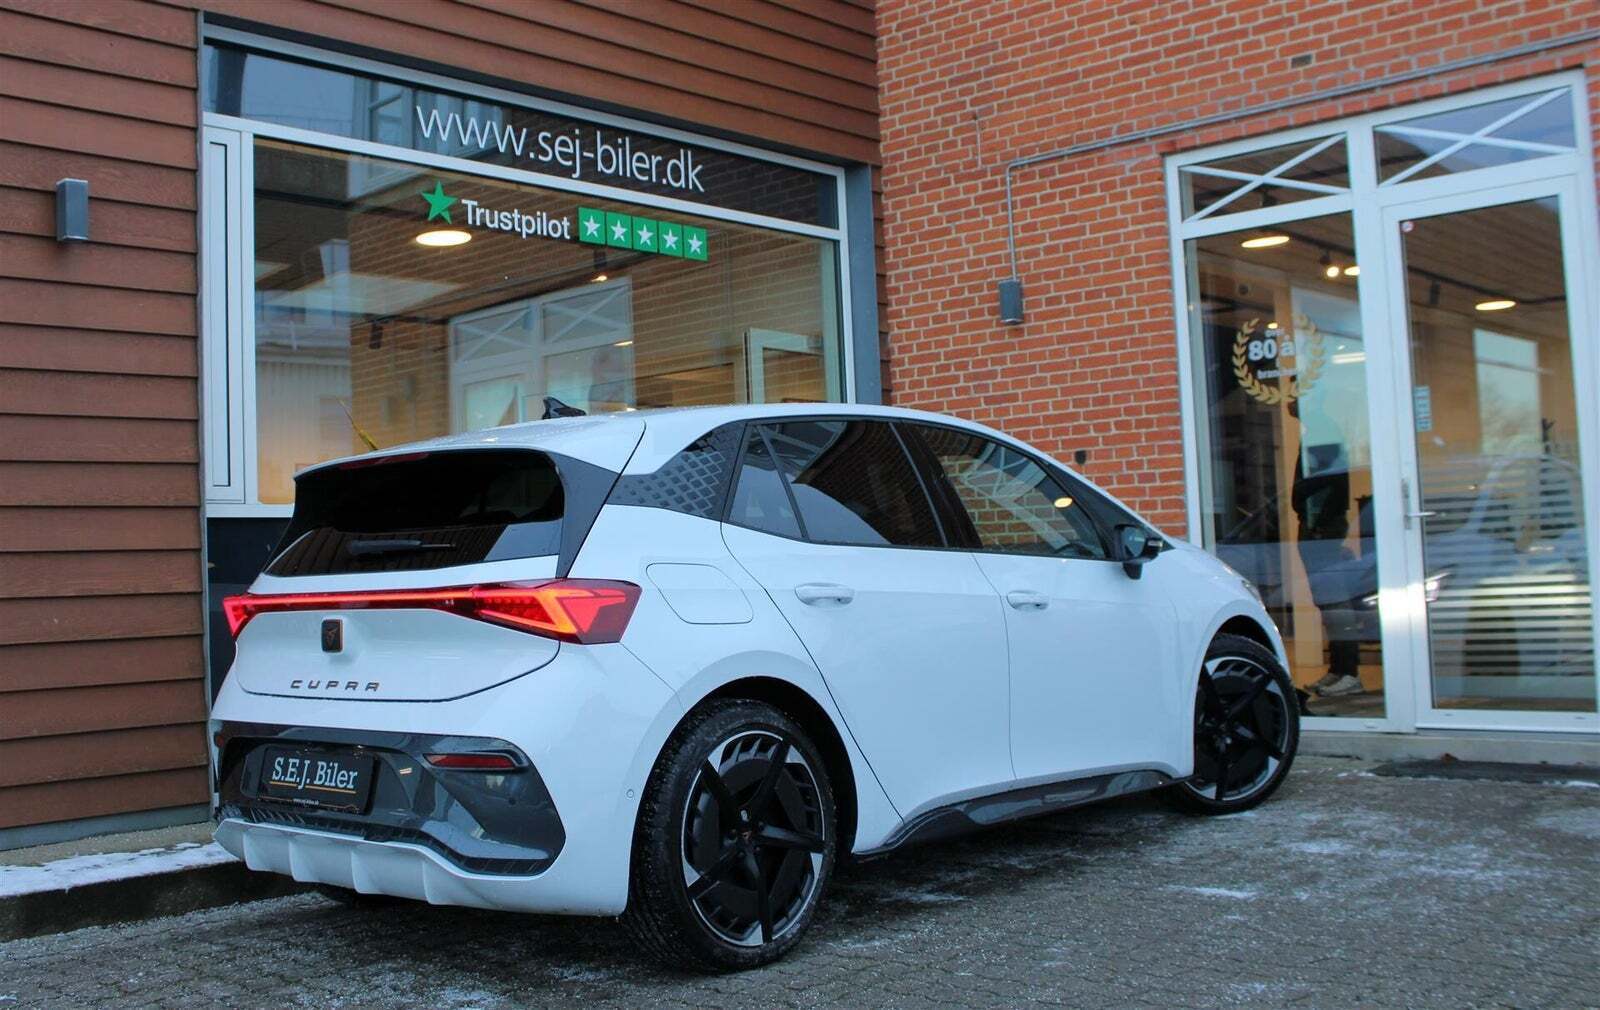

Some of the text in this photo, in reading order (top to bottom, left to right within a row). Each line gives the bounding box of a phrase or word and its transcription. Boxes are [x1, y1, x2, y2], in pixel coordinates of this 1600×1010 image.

[416, 105, 705, 193] www.sej-biler.dk
[461, 199, 571, 240] Trustpilot
[1248, 338, 1278, 361] 80
[290, 679, 380, 692] CUPRA
[272, 757, 358, 790] S.E.J. Biler
